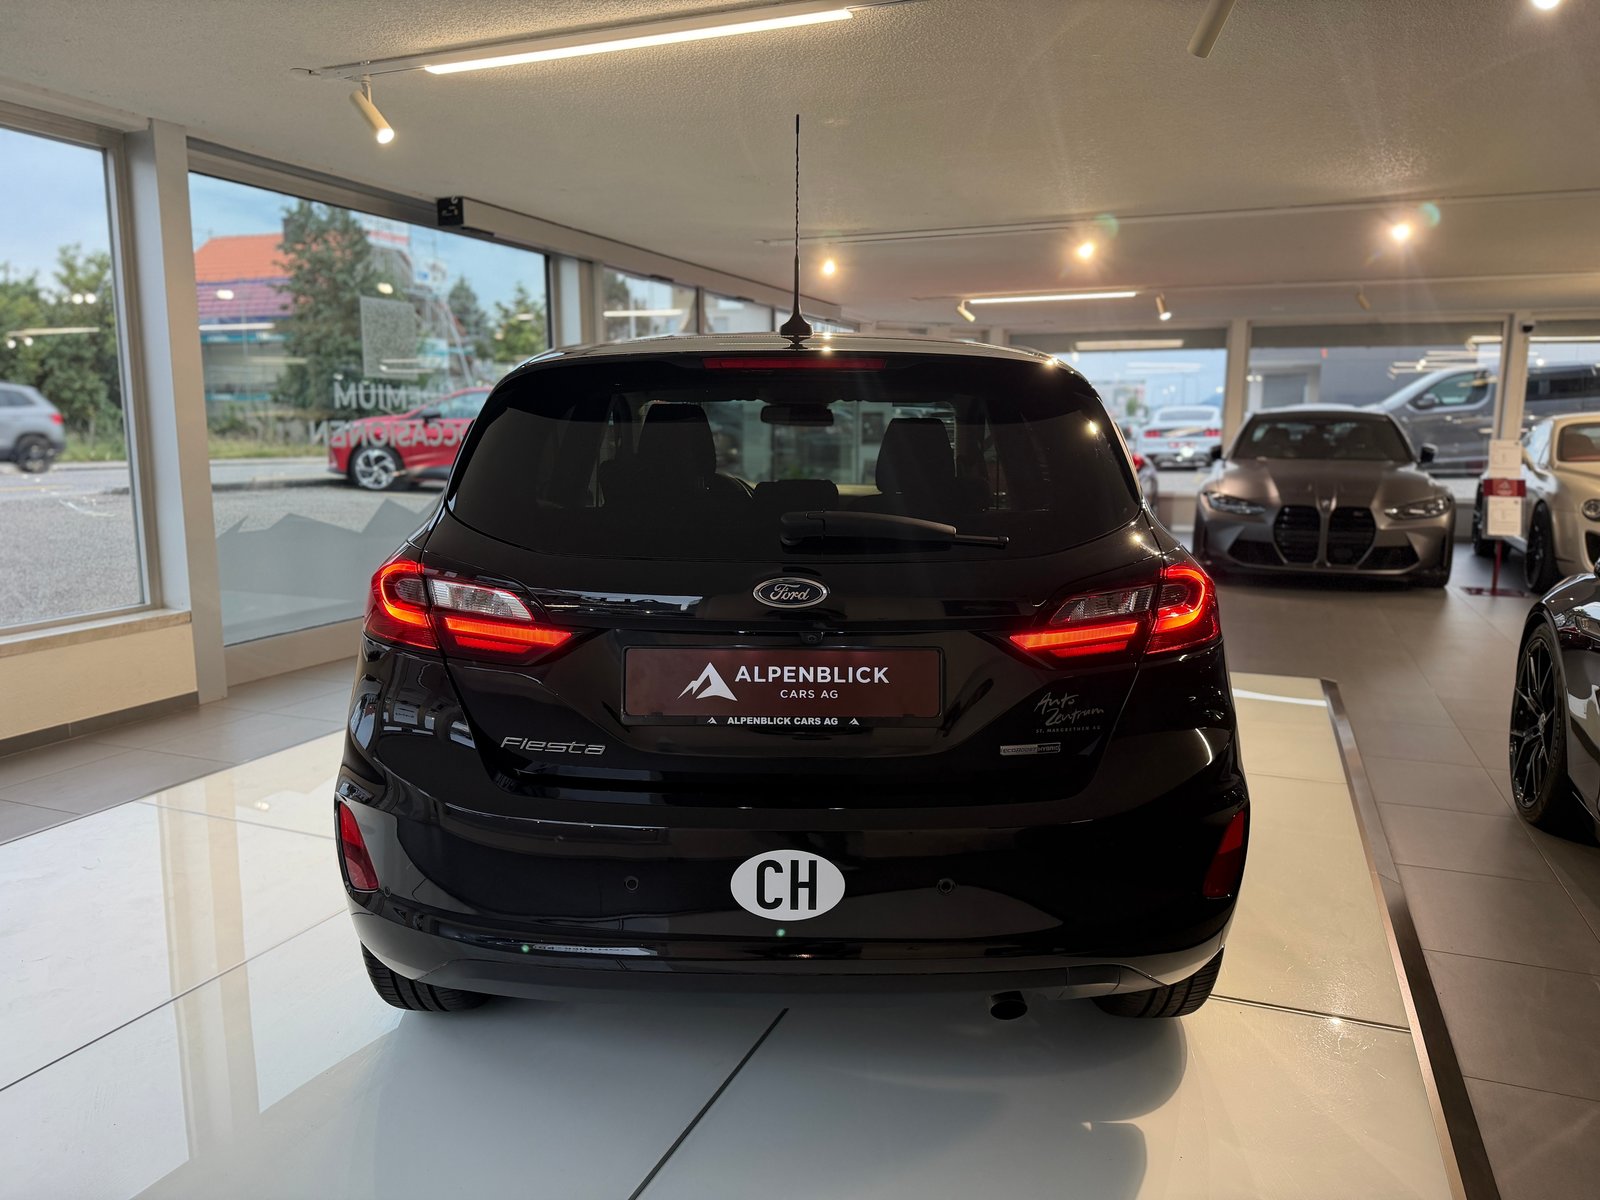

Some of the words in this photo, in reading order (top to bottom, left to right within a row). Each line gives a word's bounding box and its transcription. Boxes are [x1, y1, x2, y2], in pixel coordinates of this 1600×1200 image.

[769, 583, 811, 601] Ford
[735, 665, 890, 684] ALPENBLICK
[780, 689, 815, 699] CARS
[820, 689, 839, 699] AG
[1033, 691, 1080, 716] Auto
[727, 717, 791, 726] ALPENBLICK
[794, 717, 822, 726] CARS
[823, 717, 839, 726] AG
[500, 736, 606, 755] Fiesta
[756, 859, 818, 911] CH
